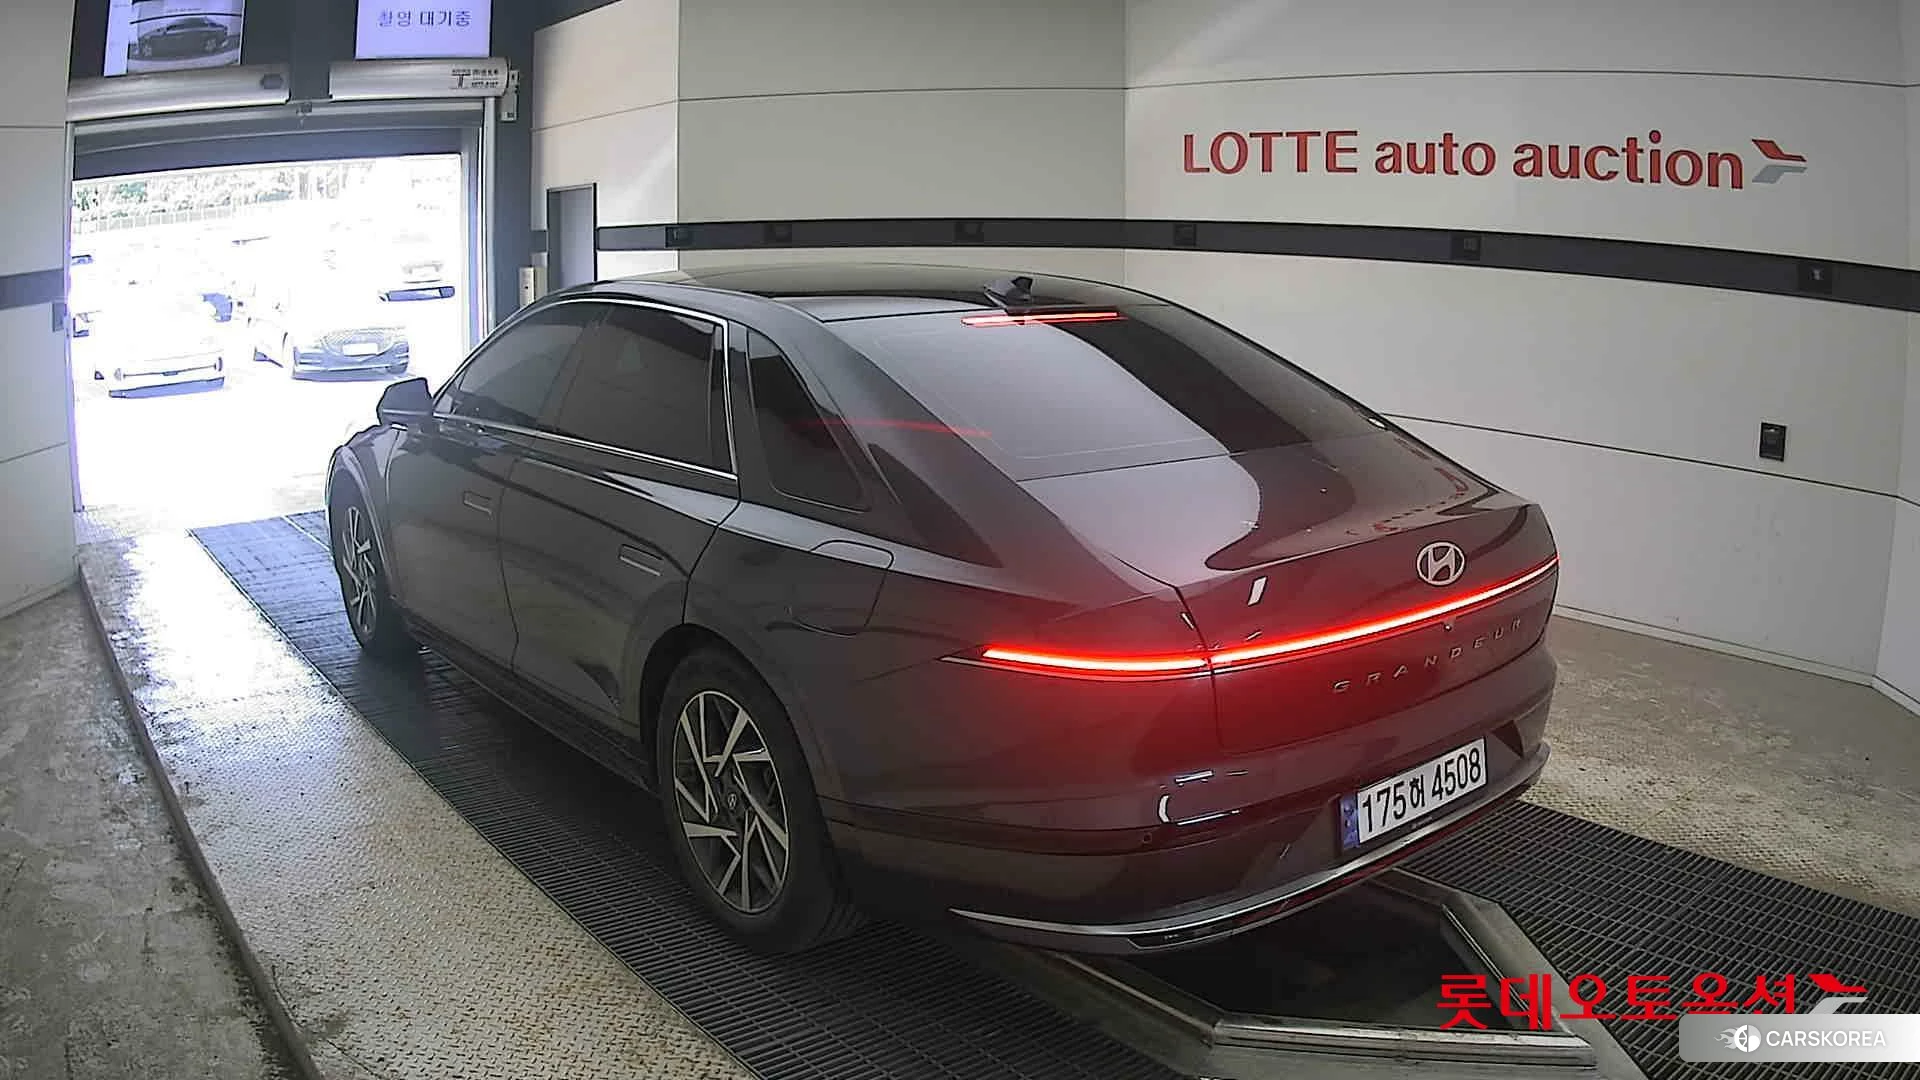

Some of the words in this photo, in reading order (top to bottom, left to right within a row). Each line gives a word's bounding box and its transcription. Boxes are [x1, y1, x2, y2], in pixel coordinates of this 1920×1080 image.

[419, 10, 471, 27] 대기중
[1184, 131, 1358, 174] LOTTE
[1375, 132, 1496, 176] auto
[1513, 130, 1744, 189] auction
[1431, 748, 1482, 800] 4508
